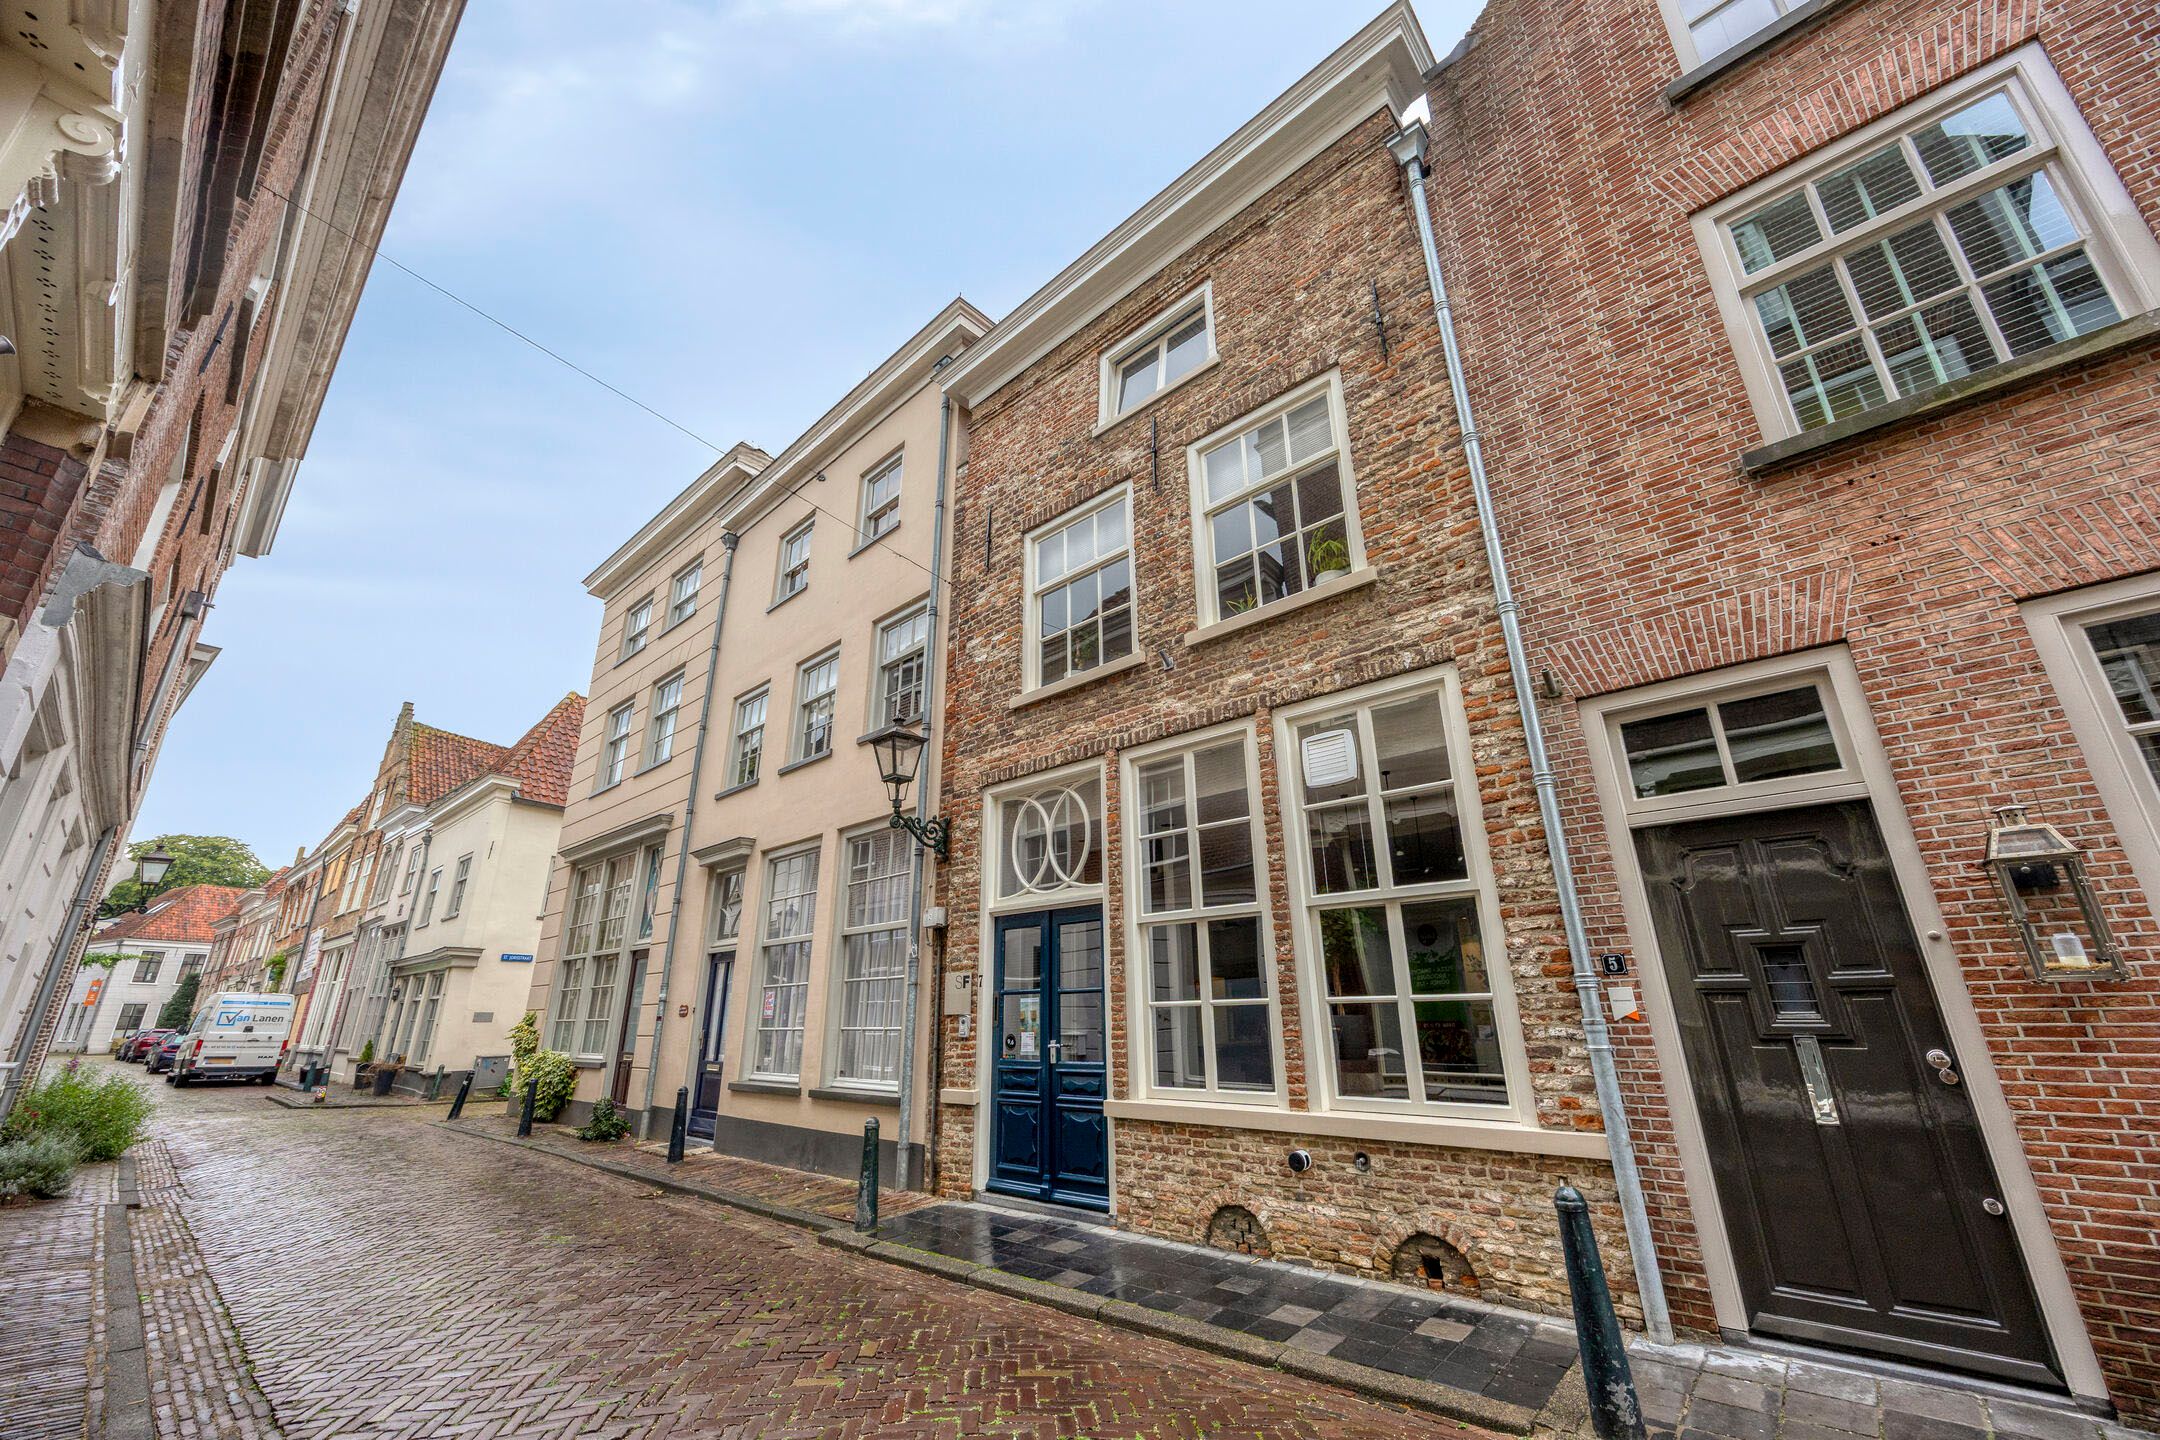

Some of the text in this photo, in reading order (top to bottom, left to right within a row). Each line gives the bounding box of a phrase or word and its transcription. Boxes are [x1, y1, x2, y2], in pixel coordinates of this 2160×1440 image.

[1608, 957, 1618, 971] 5
[955, 975, 970, 989] SF
[979, 975, 983, 987] 7
[226, 1010, 284, 1023] Van Lanen
